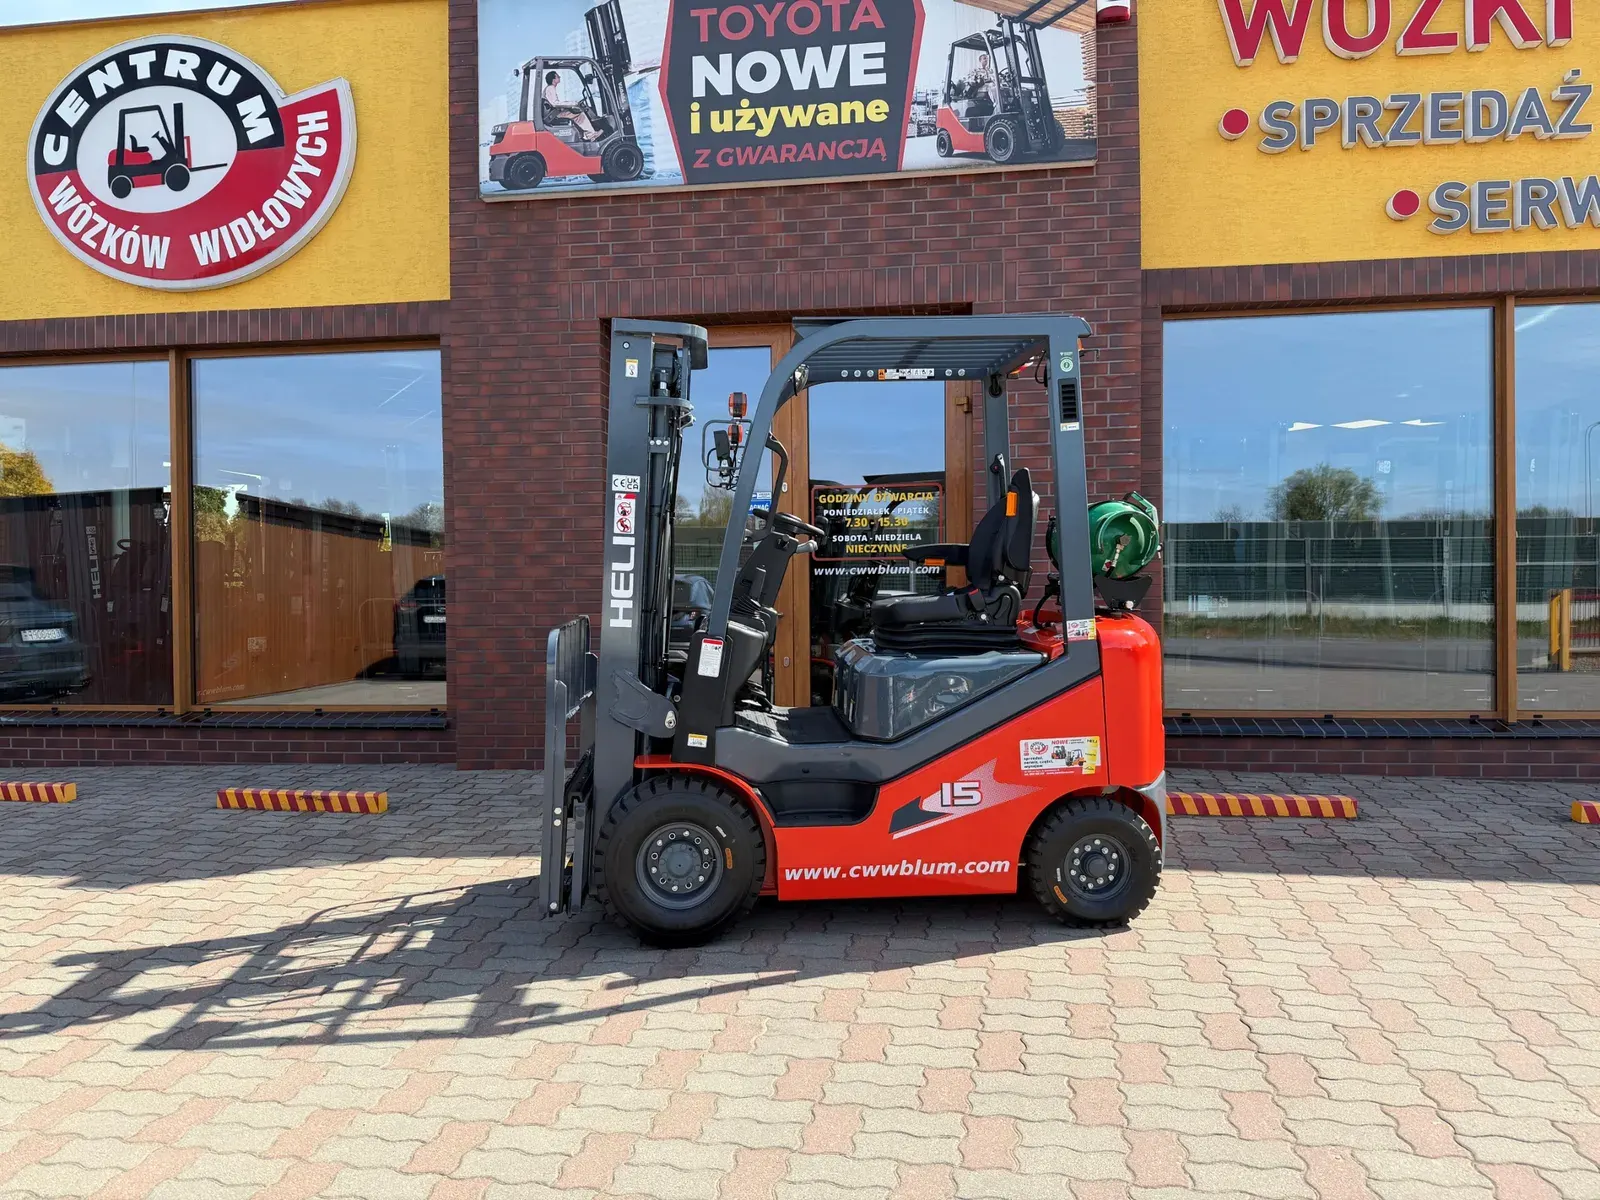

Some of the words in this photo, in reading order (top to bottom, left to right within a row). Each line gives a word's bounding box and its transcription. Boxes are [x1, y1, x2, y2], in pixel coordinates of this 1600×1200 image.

[690, 0, 885, 42] TOYOTA
[692, 41, 887, 98] NOWE
[43, 48, 275, 166] CENTRUM
[690, 101, 700, 134] i
[710, 98, 890, 138] używane
[1256, 68, 1594, 154] SPRZEDAŻ
[693, 149, 711, 169] Z
[716, 137, 887, 166] GWARANCJĄ
[48, 176, 171, 270] WÓZKÓW
[189, 110, 329, 267] WIDŁOWYCH
[1427, 175, 1600, 235] SERW
[819, 493, 870, 504] GODZINY
[873, 492, 934, 503] OTWARCIA
[823, 507, 890, 516] PONIEDZIAŁEK
[897, 507, 930, 516] PIĄTEK
[832, 534, 868, 542] SOBOTA
[874, 533, 922, 542] NIEDZIELA
[845, 517, 868, 528] 7.30
[879, 517, 908, 527] 15.30
[846, 544, 908, 554] NIECZYNNE
[609, 536, 636, 628] HELI
[814, 564, 940, 576] www.cwwblum.com
[940, 780, 983, 807] 15
[785, 859, 1010, 881] www.cwwblum.com
